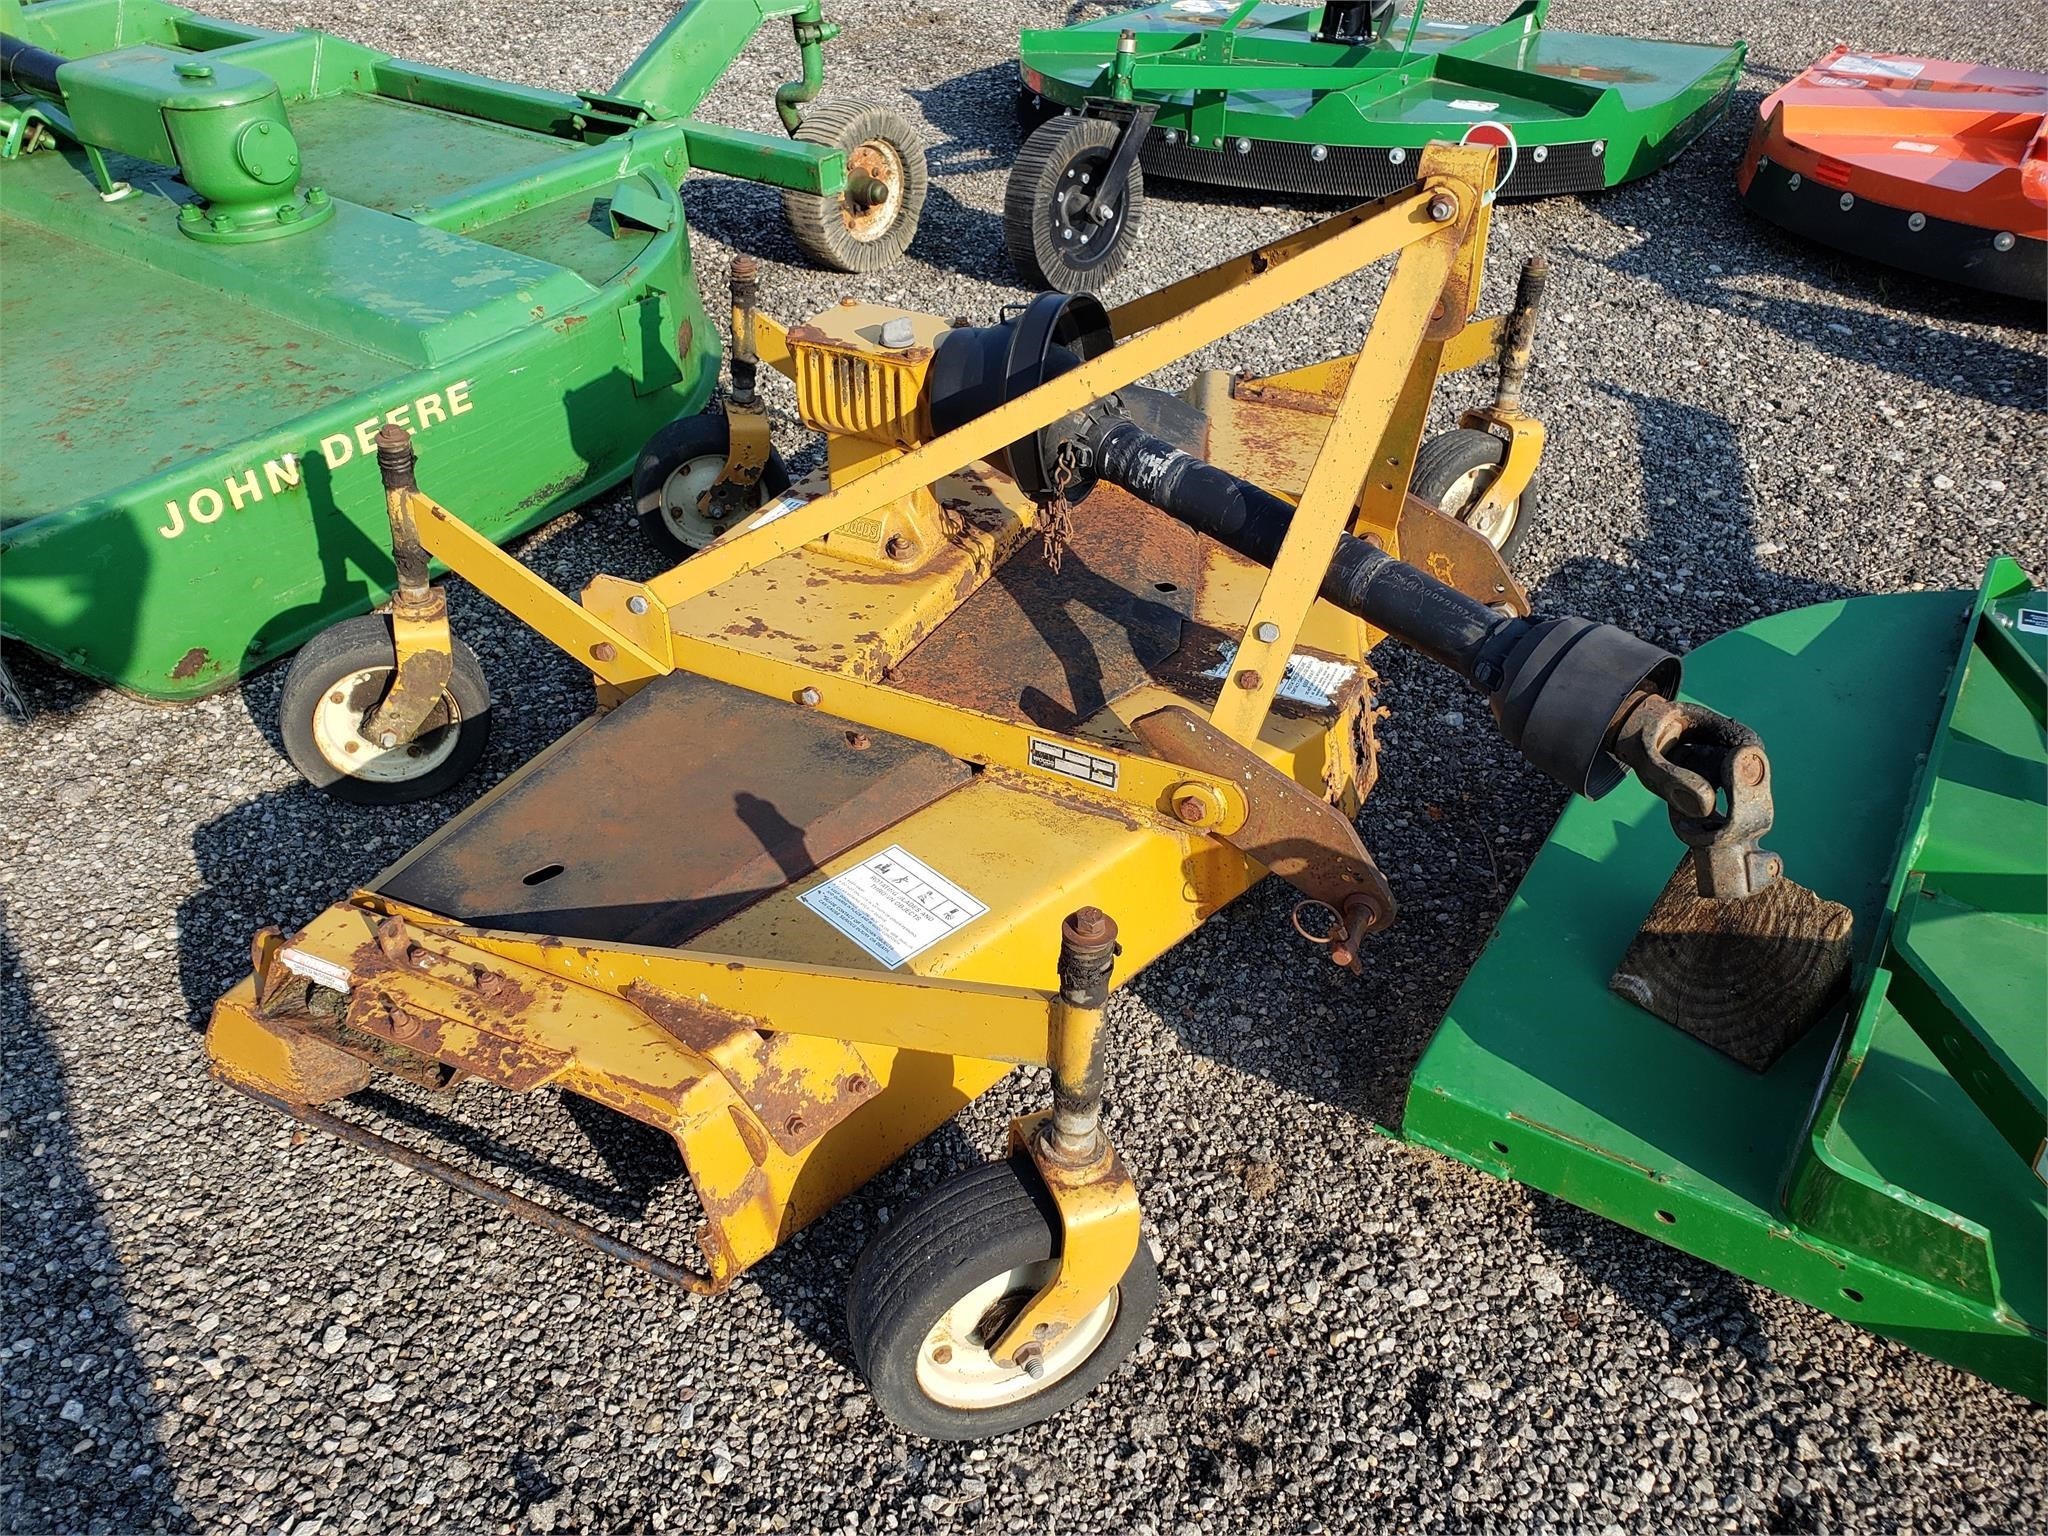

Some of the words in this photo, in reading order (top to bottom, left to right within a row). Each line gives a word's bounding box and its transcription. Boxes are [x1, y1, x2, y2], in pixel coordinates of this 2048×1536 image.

[158, 452, 301, 539] JOHN
[319, 380, 473, 470] DEERE
[868, 875, 899, 896] ROTATING
[896, 895, 921, 912] BLADES
[918, 911, 935, 921] AND
[869, 883, 896, 902] THROWN
[893, 901, 922, 921] OBJECTS
